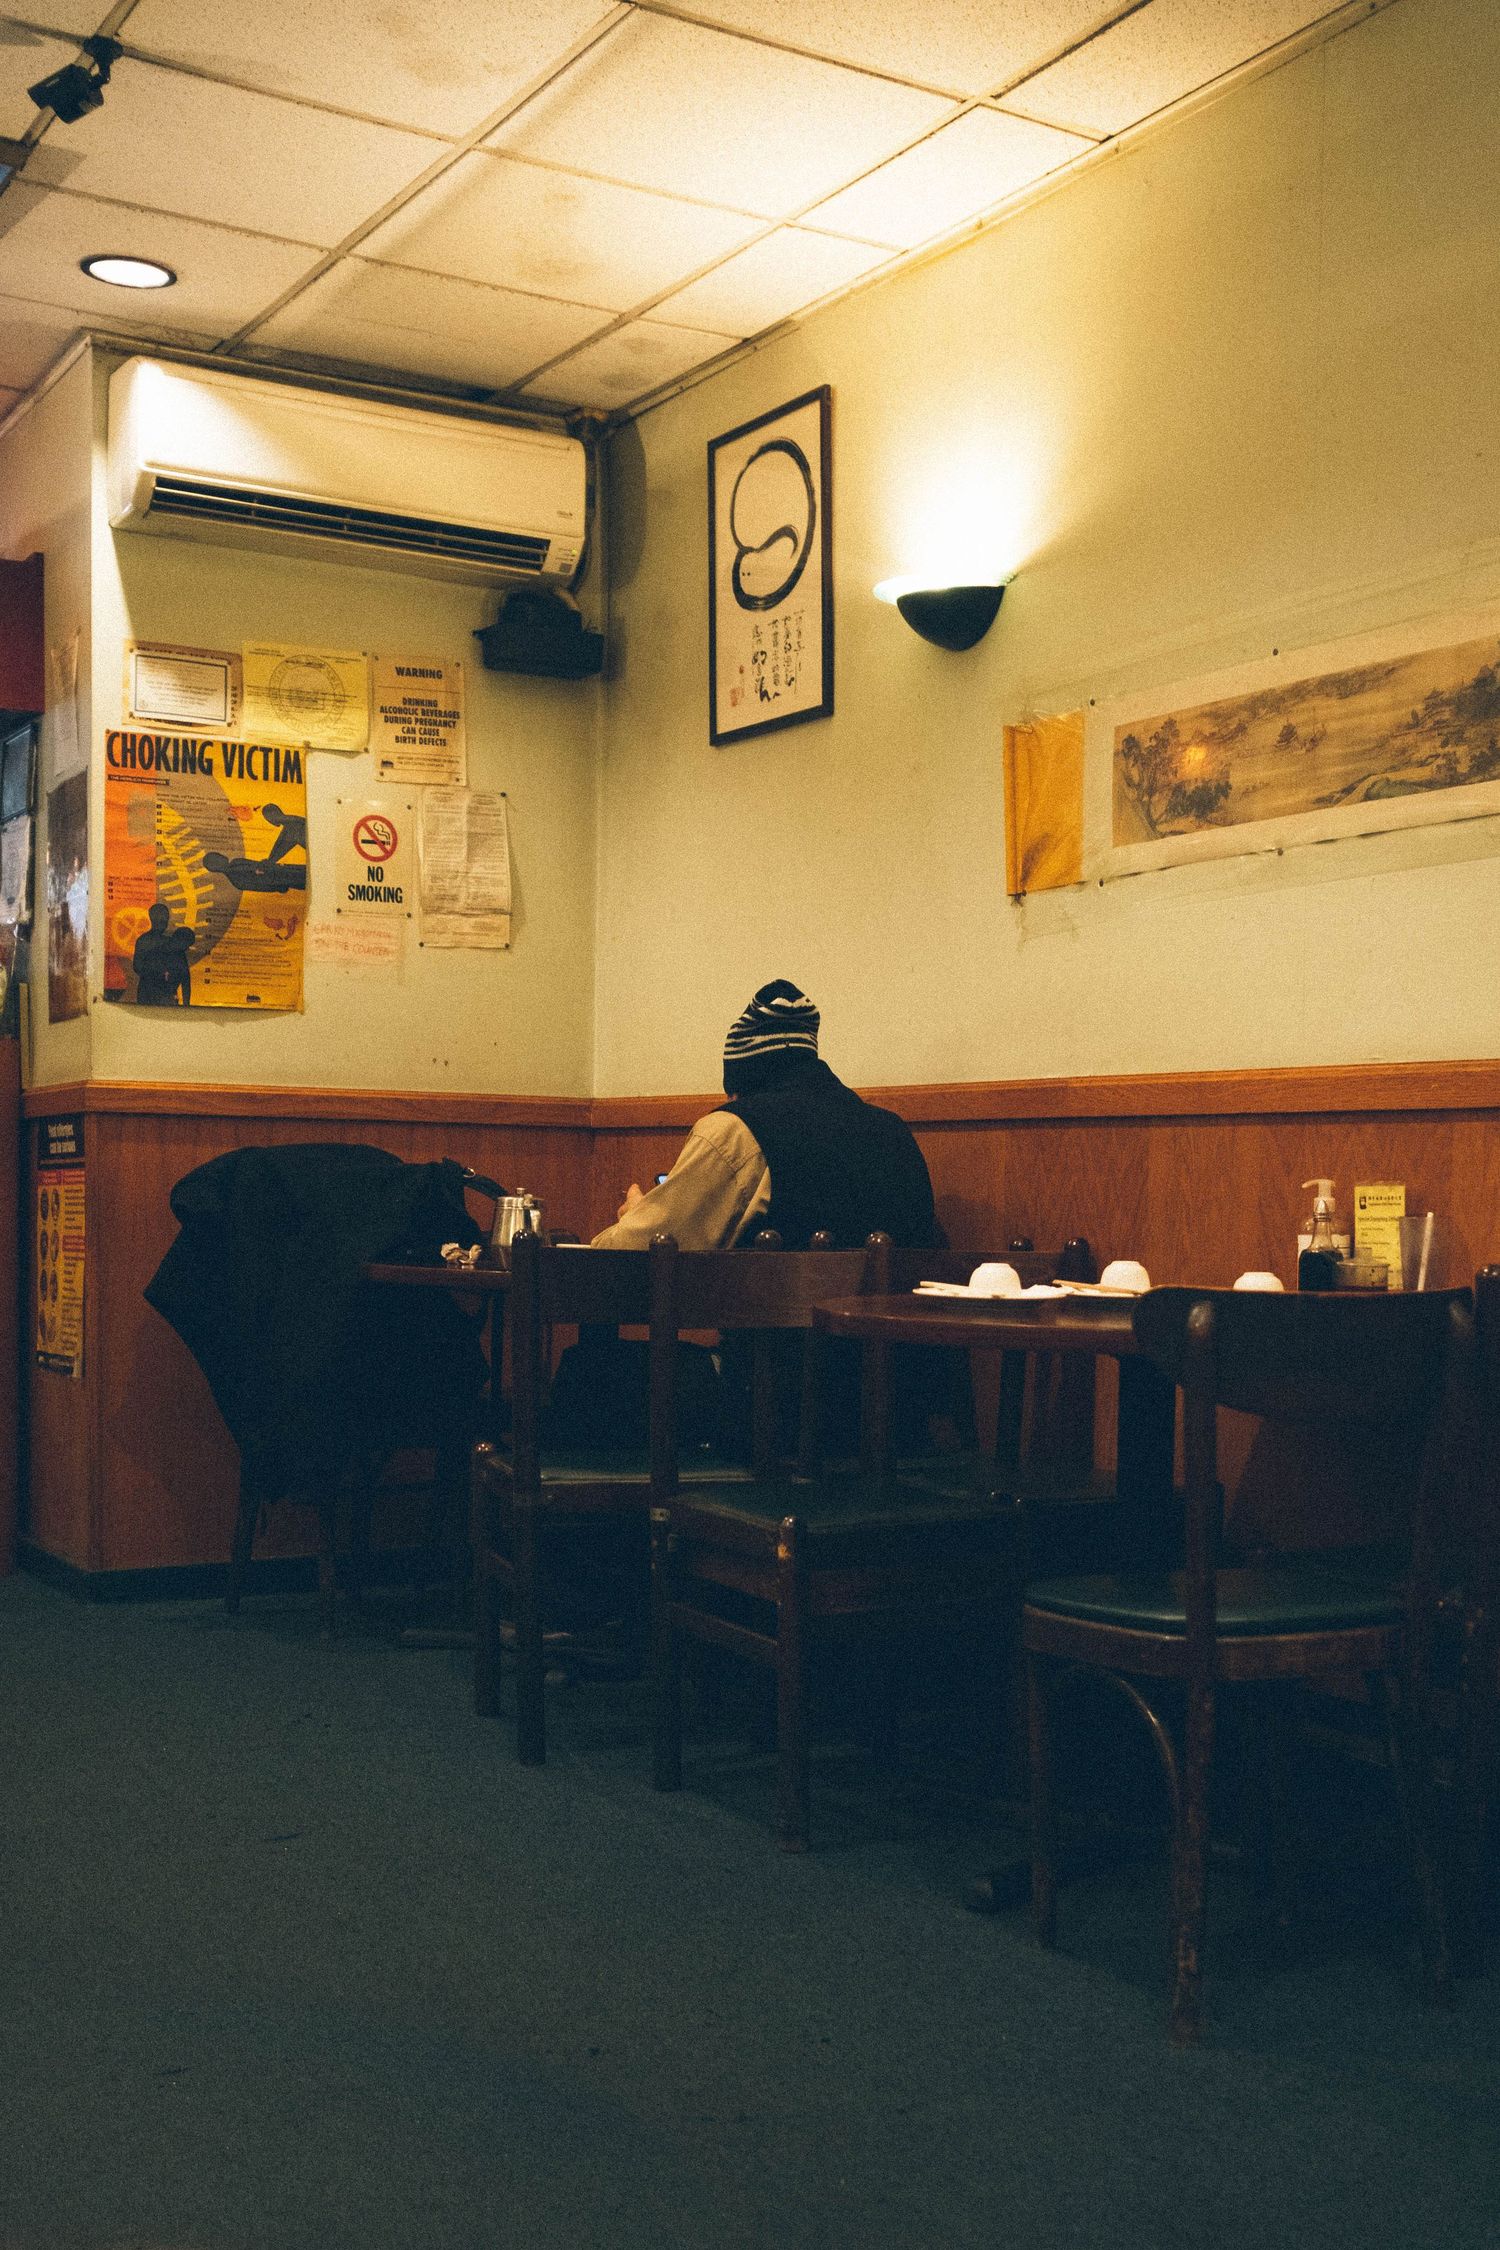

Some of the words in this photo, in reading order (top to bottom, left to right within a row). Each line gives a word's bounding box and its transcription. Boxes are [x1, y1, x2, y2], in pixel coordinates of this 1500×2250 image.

[394, 666, 443, 680] WARNING
[402, 698, 438, 707] DRINKING
[380, 706, 419, 716] ALCOHOLIC
[421, 708, 460, 719] BEVERAGES
[383, 715, 413, 725] DURING
[414, 717, 457, 729] PREGNANCY
[401, 726, 417, 735] CAN
[418, 727, 440, 736] CAUSE
[395, 735, 416, 744] BIRTH
[418, 738, 447, 746] DEFECTS
[106, 731, 214, 777] CHOKING
[221, 742, 303, 785] VICTIM
[367, 865, 384, 883] NO
[347, 884, 403, 904] SMOKING
